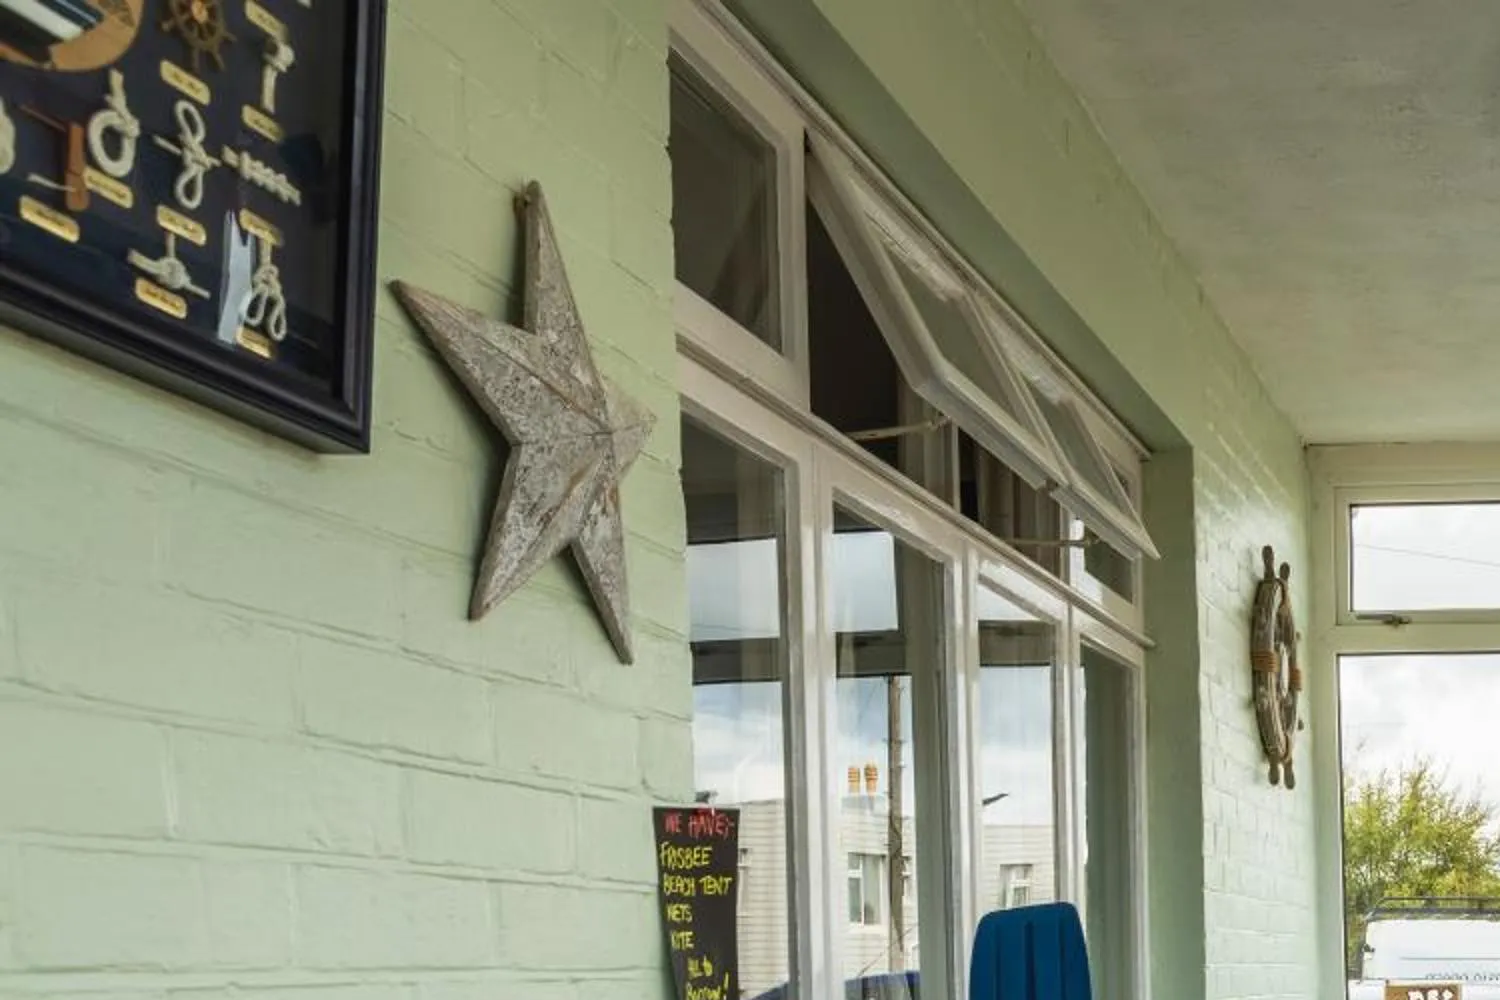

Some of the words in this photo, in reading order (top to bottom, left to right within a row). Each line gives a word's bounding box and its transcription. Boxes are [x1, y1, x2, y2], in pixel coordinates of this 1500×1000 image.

[660, 841, 713, 870] FRISBEE
[663, 873, 696, 897] BEACH
[699, 875, 733, 895] TENT
[671, 930, 695, 950] KITE
